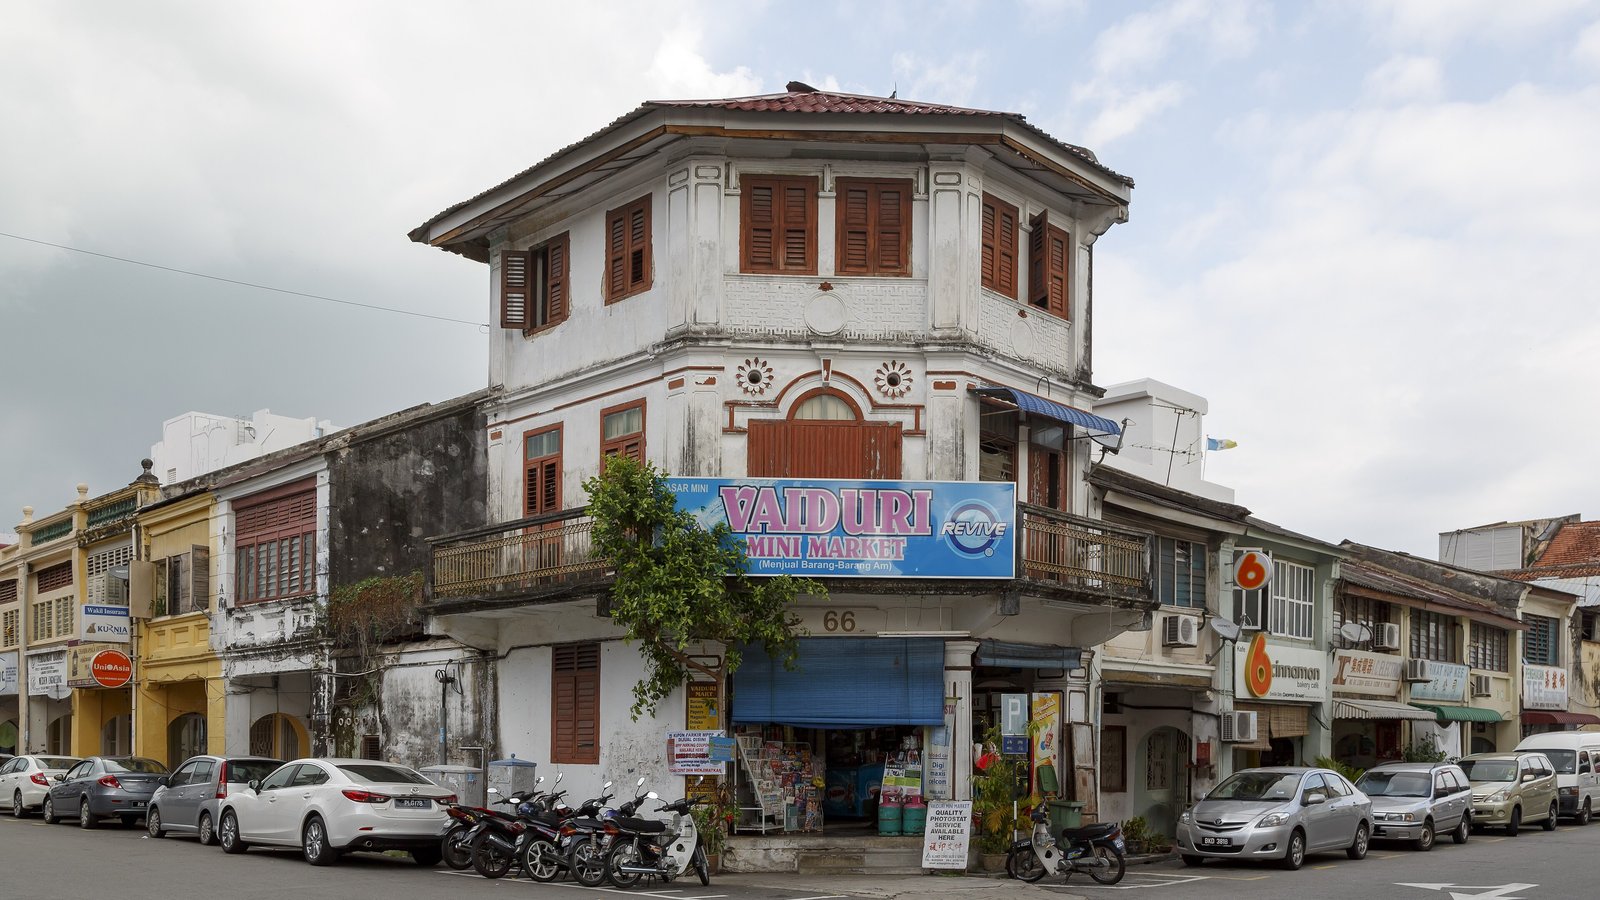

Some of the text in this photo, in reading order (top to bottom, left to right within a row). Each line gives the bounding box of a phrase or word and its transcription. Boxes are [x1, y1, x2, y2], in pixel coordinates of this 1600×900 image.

[691, 484, 709, 493] MINI
[719, 485, 933, 536] VAIDURI
[941, 521, 1007, 536] REVIVE
[747, 536, 907, 561] MINI MARKET
[759, 560, 893, 572] (Menjual Barang-Barang Am)
[824, 611, 855, 632] 66
[98, 625, 127, 634] KURNIA
[1009, 699, 1020, 731] P
[932, 761, 944, 769] Digi
